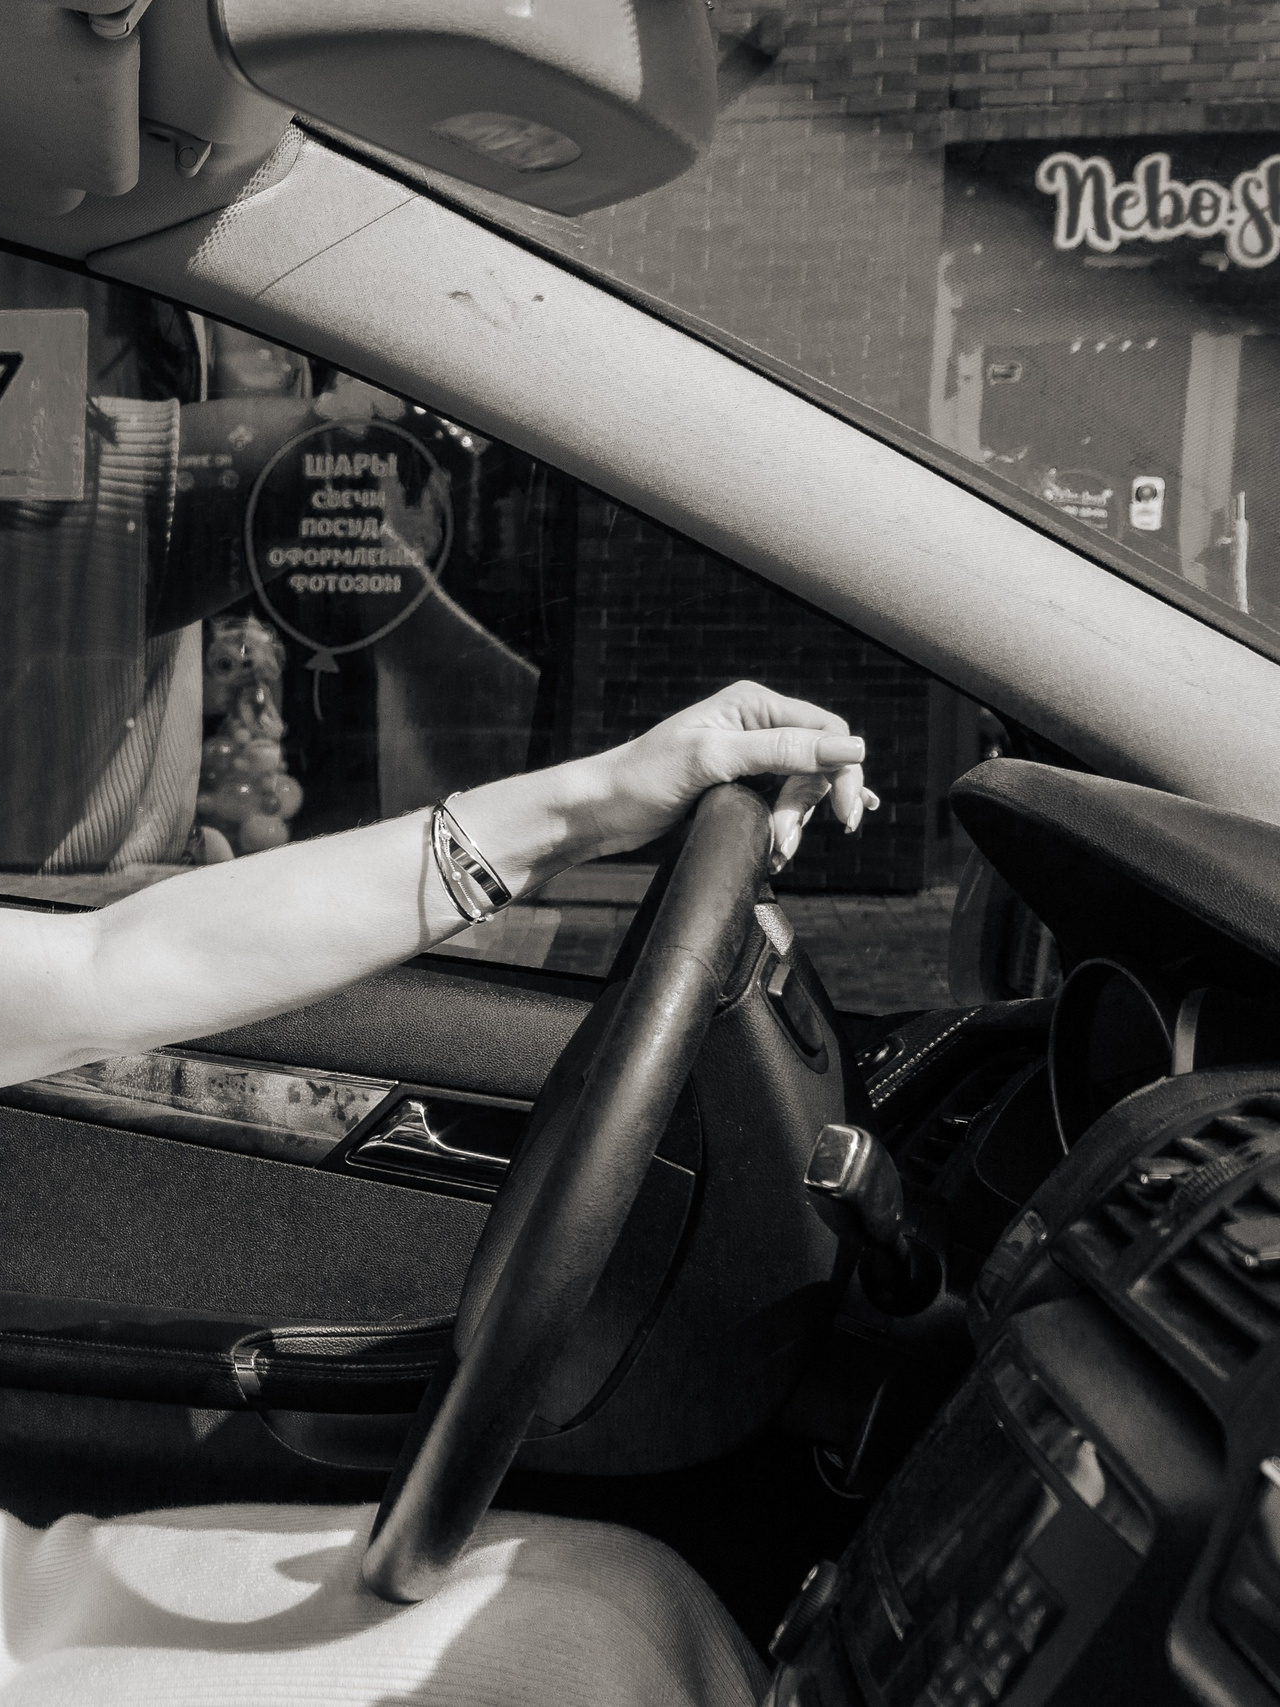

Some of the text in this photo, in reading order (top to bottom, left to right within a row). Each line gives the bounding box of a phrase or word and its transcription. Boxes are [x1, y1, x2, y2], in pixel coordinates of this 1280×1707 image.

[304, 453, 398, 478] ШАРЫ
[311, 489, 386, 509] СВЕЧИ
[269, 548, 422, 567] ОФОРМЛЕНИ
[290, 574, 402, 594] ФОТОЗОН
